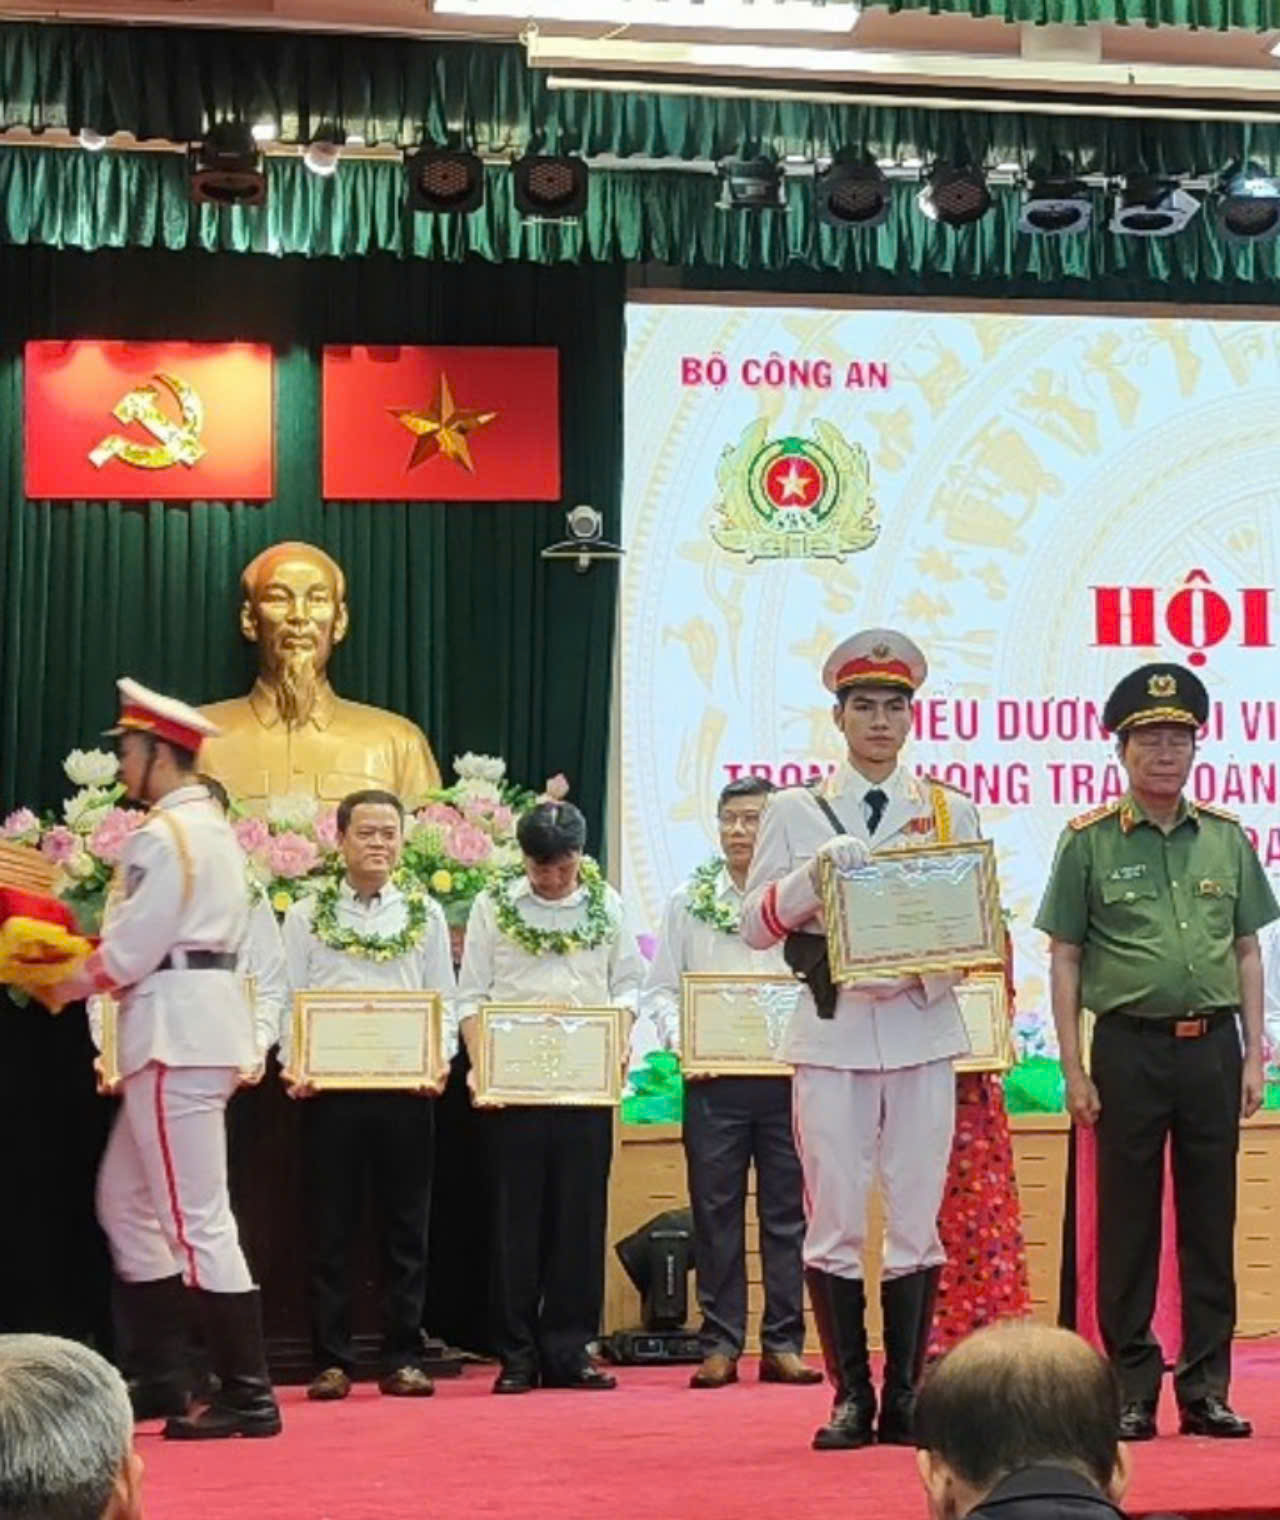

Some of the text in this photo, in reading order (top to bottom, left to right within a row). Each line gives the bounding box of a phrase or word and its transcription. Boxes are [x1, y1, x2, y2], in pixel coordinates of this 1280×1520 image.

[682, 351, 888, 391] BỘ CÔNG AN
[1088, 568, 1275, 668] HỘI
[997, 696, 1110, 741] DƯƠN
[1046, 754, 1125, 804] TRÀ
[1194, 754, 1276, 804] OÀN
